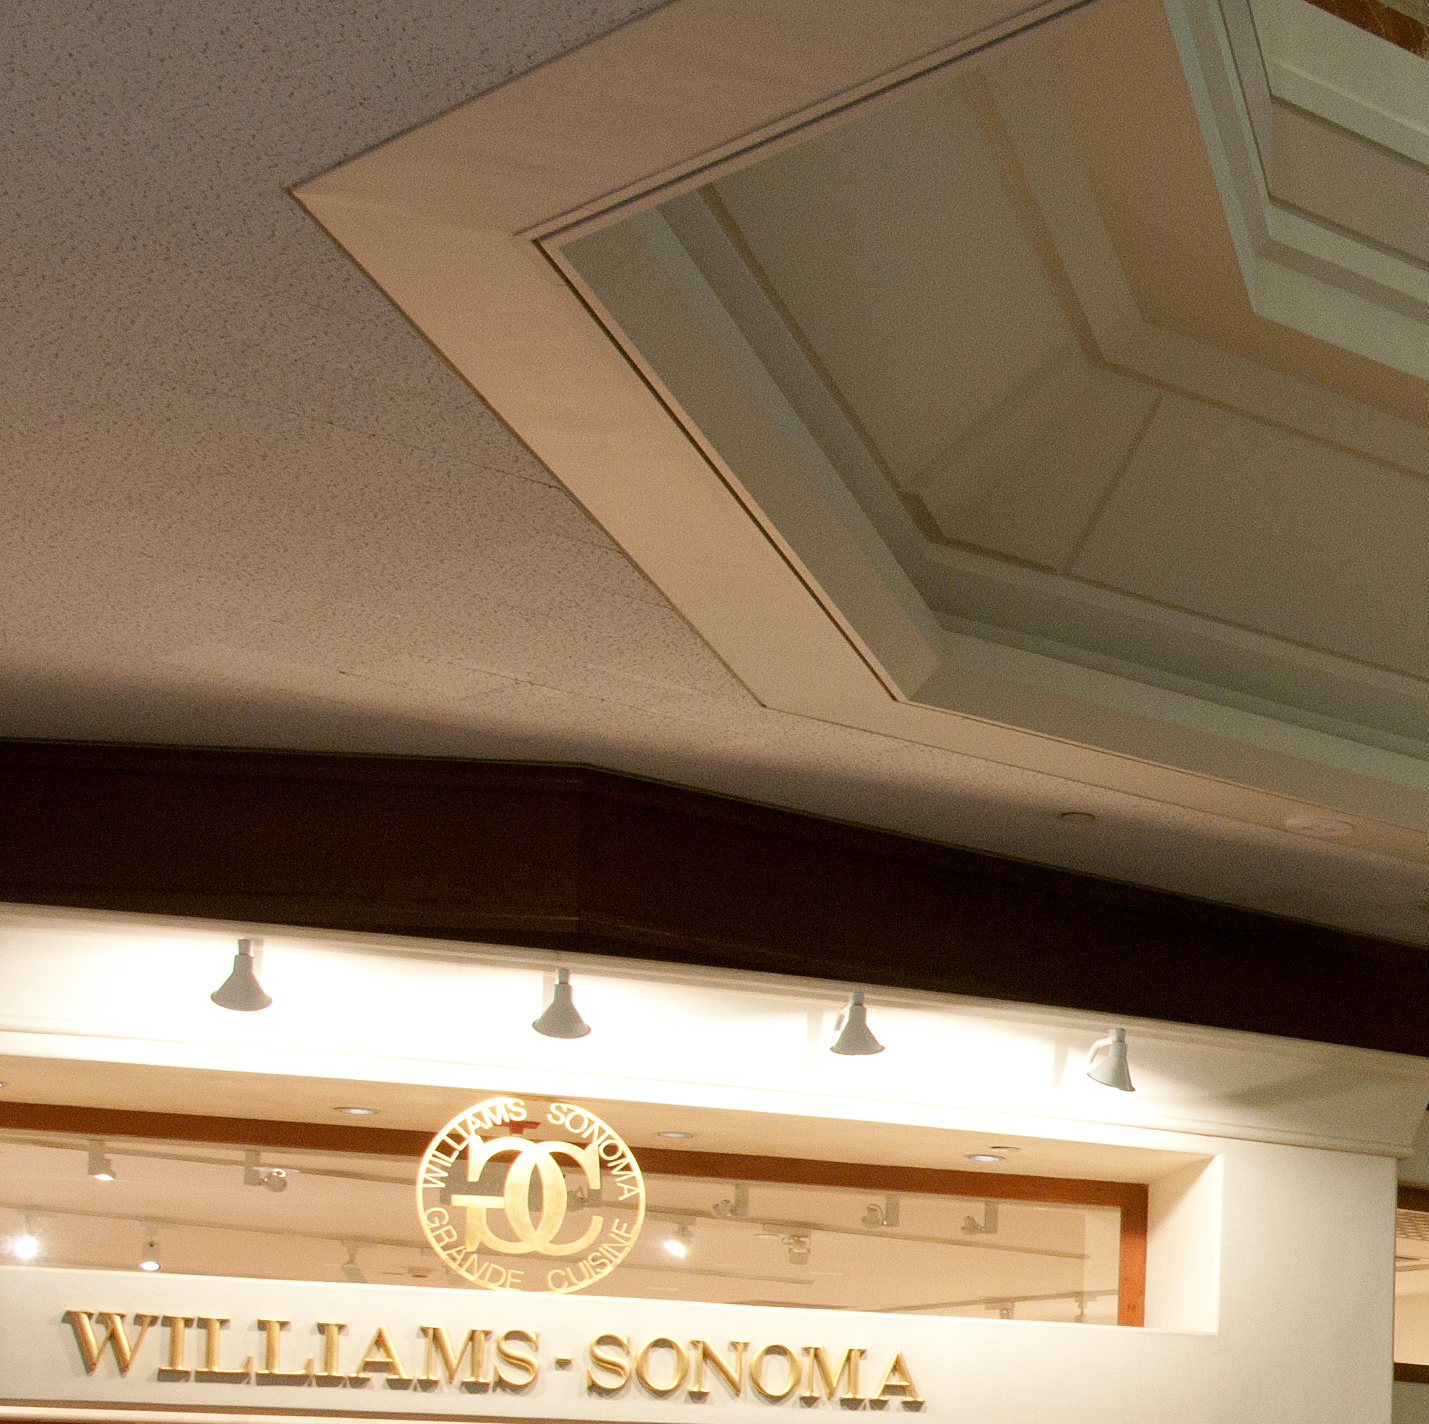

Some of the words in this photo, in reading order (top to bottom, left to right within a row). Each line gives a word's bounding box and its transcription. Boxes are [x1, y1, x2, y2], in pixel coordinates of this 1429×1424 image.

[420, 1097, 528, 1190] WILLIAMS
[547, 1101, 641, 1201] SONOMA
[422, 1206, 526, 1291] GRANDE
[547, 1217, 636, 1291] CUISINE
